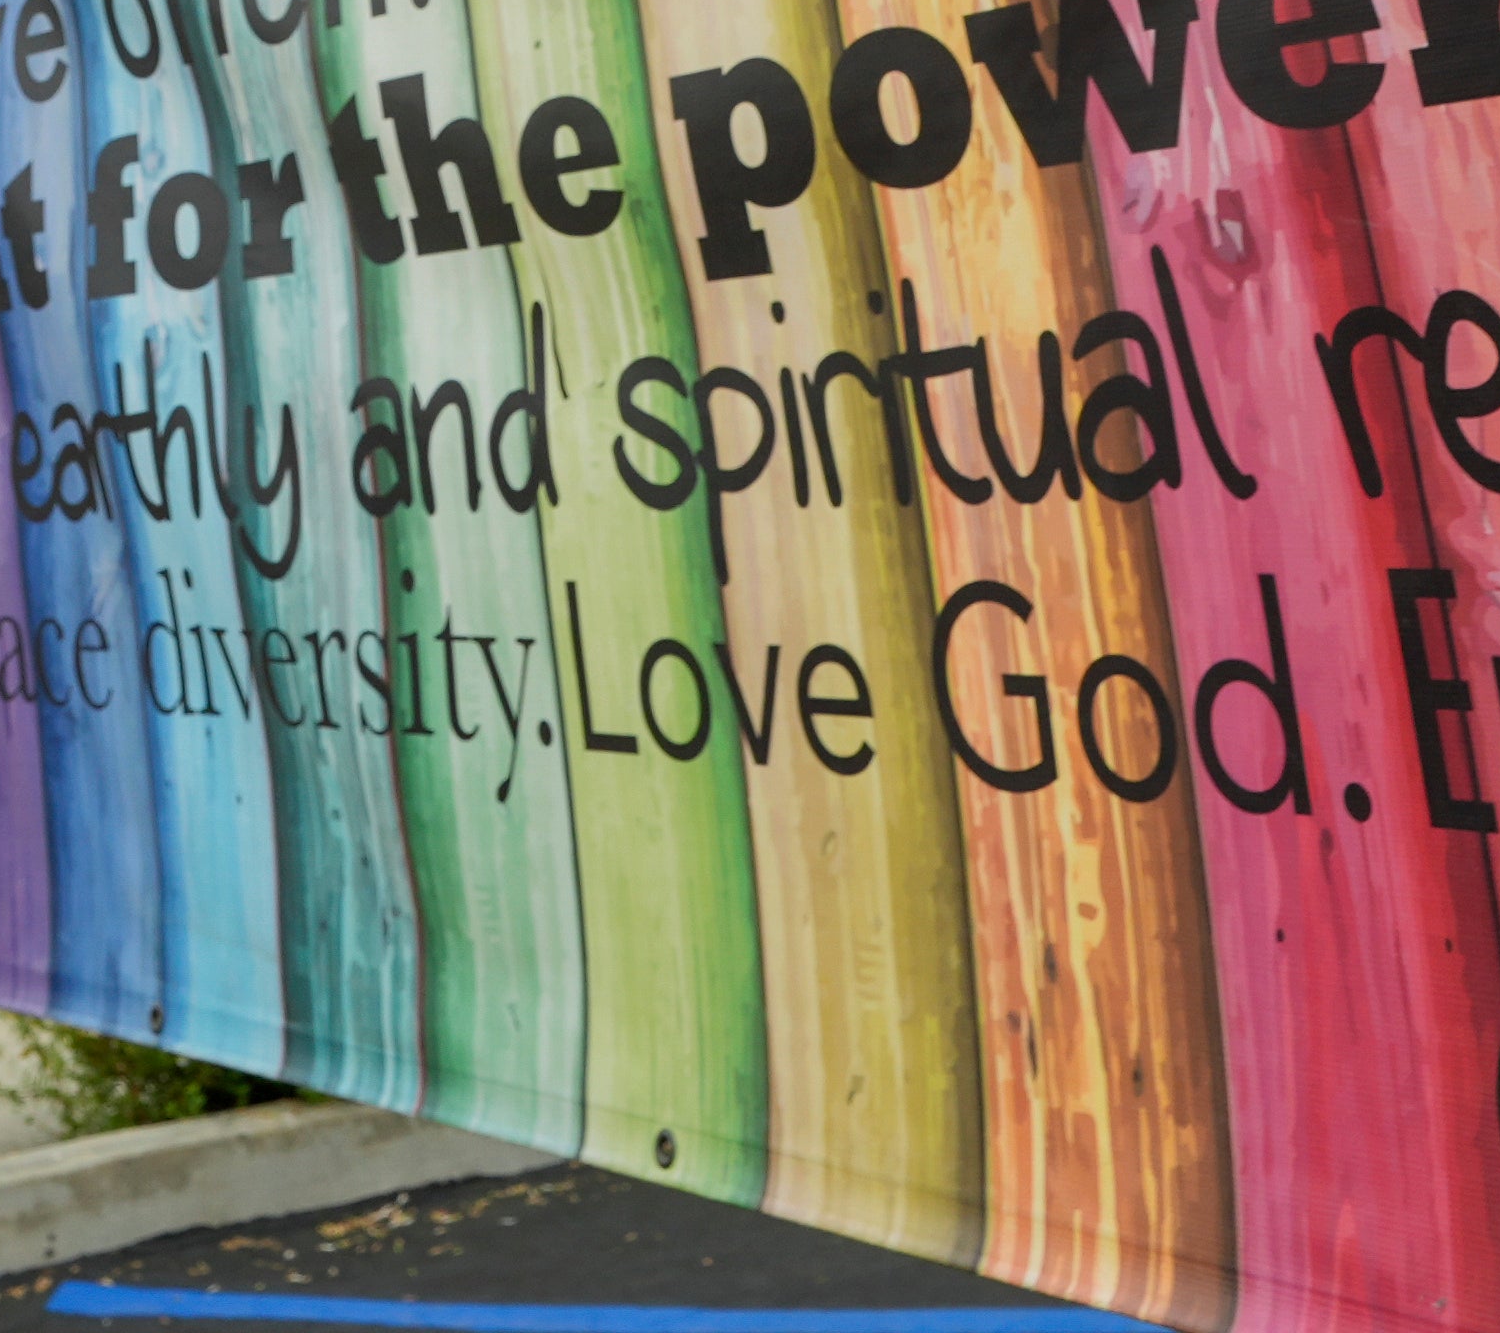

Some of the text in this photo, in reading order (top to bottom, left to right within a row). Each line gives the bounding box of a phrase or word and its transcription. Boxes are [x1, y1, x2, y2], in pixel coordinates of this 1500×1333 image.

[86, 133, 306, 301] for
[327, 73, 625, 265] the
[12, 336, 301, 580] earthly
[348, 302, 560, 516] and
[612, 244, 1258, 586] spiritual
[143, 568, 555, 803] diversity.
[566, 580, 875, 776] Love
[932, 574, 1372, 823] God.
